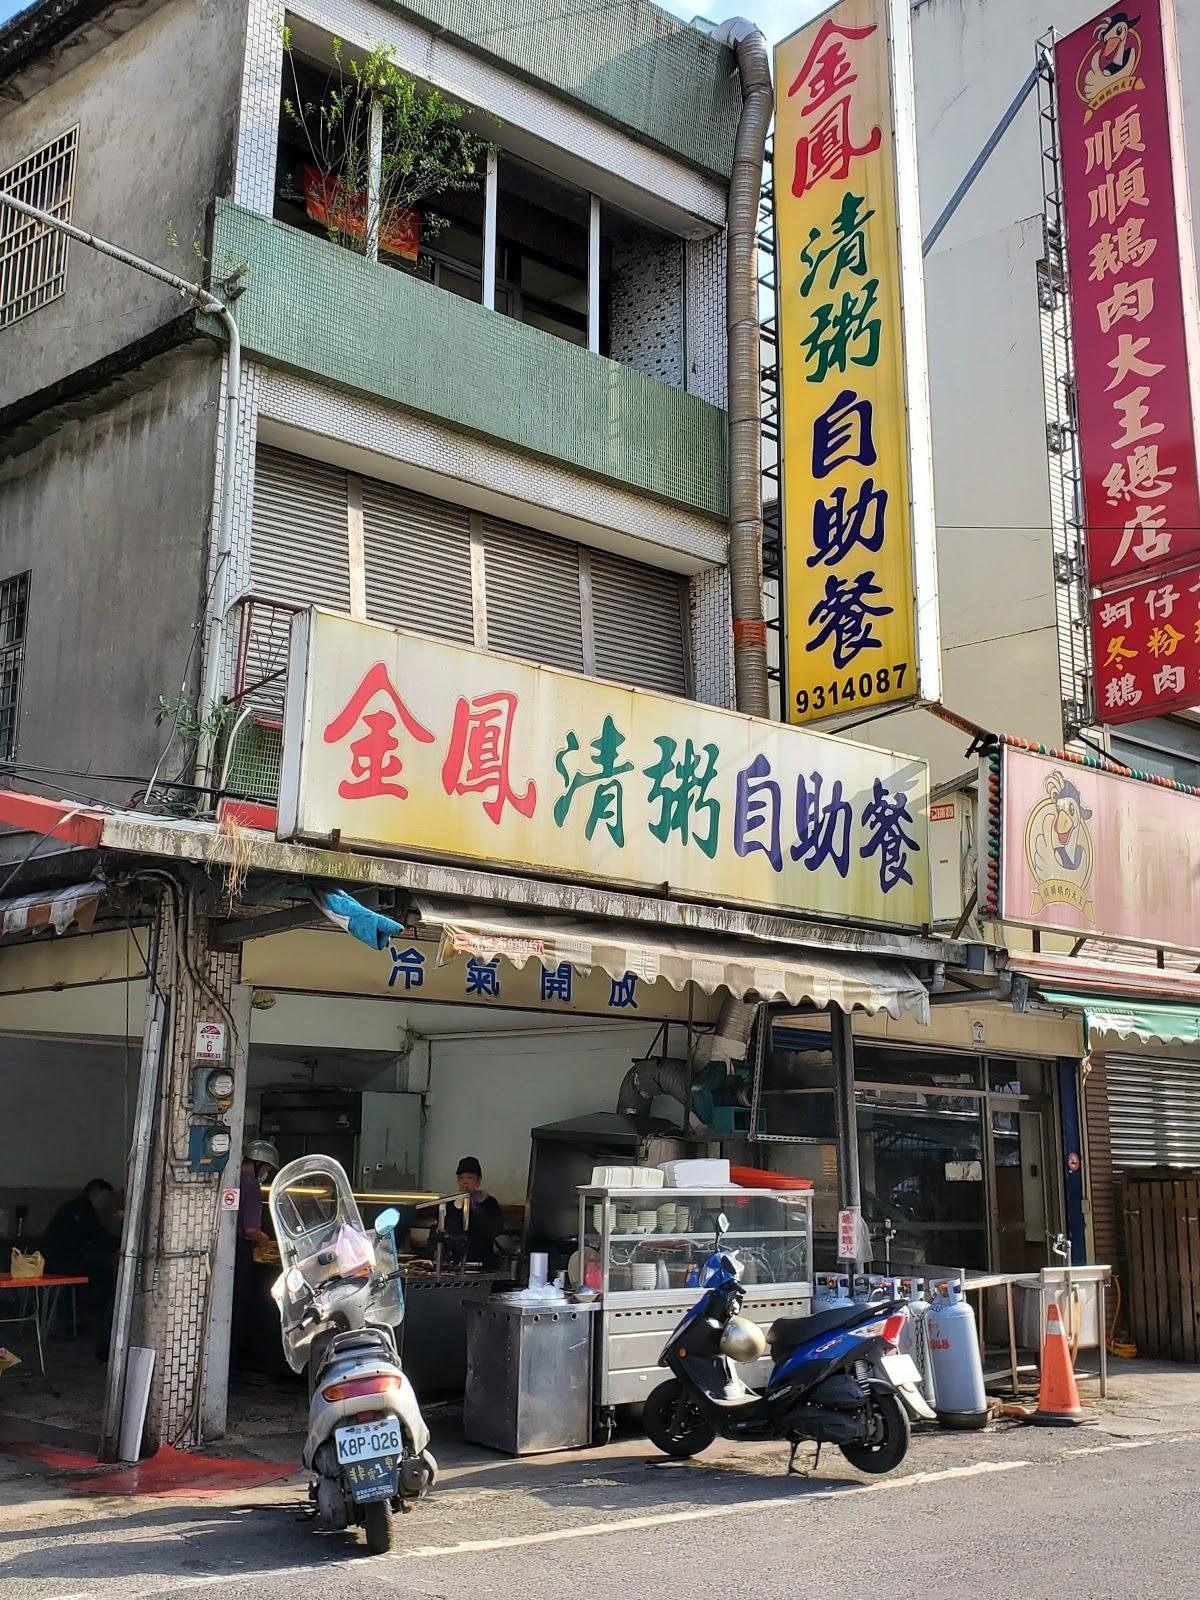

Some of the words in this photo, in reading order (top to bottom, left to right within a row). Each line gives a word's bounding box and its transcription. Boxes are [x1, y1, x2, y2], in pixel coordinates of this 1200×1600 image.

[796, 663, 907, 714] 9314087
[1104, 664, 1200, 708] 鵝肉
[206, 1040, 213, 1052] 6
